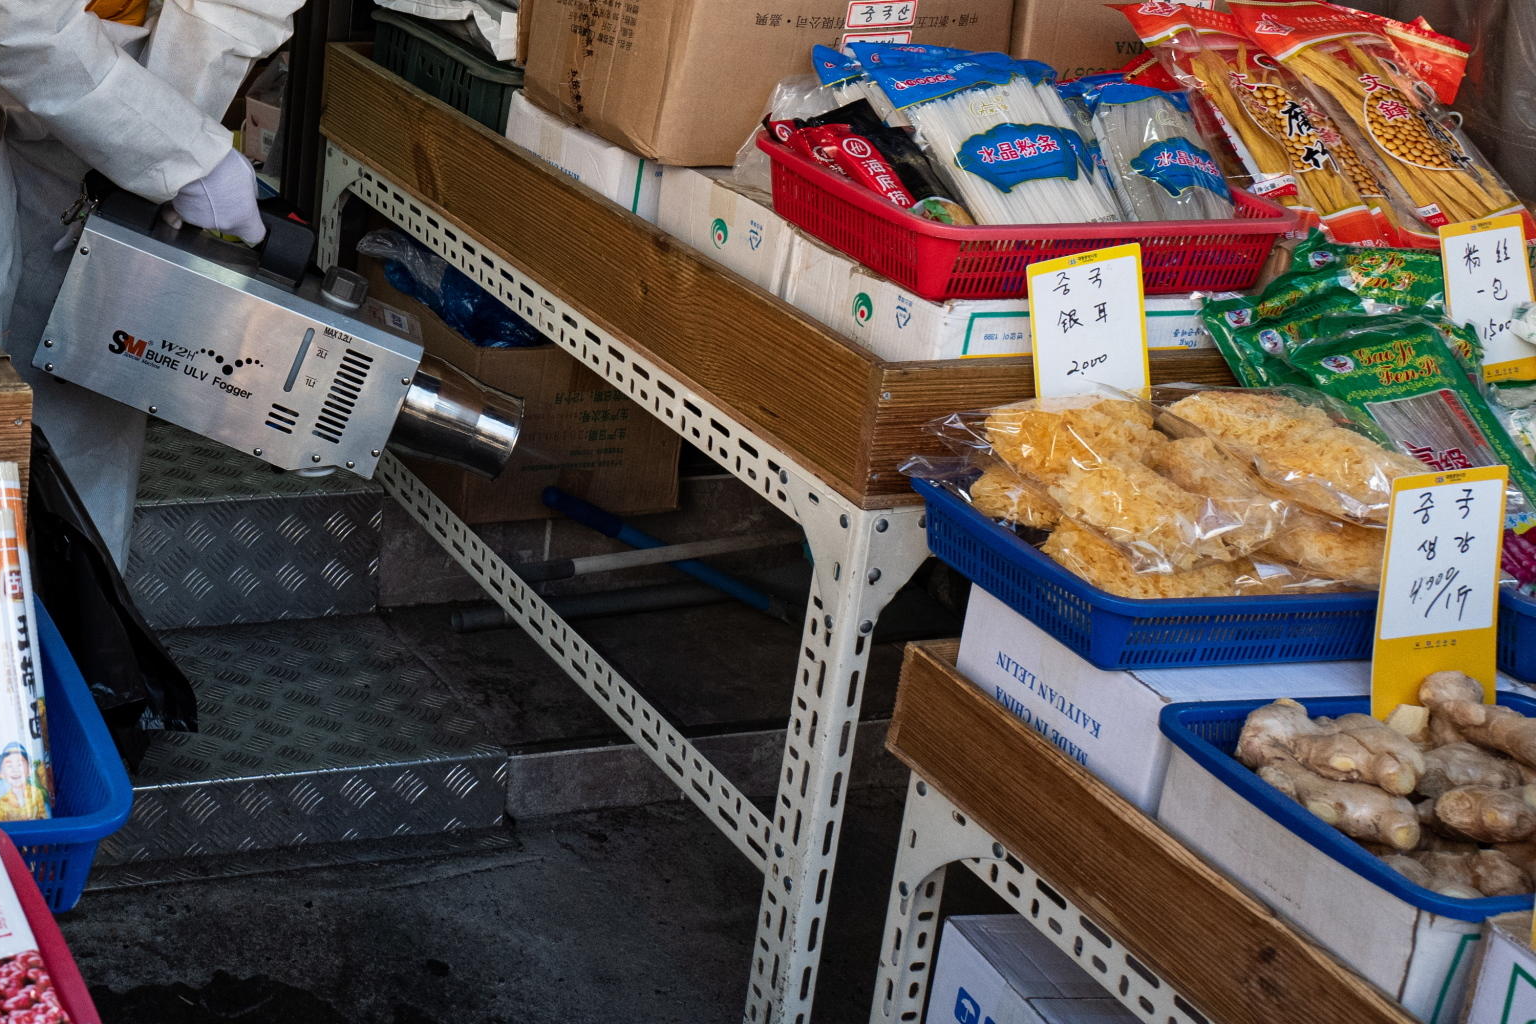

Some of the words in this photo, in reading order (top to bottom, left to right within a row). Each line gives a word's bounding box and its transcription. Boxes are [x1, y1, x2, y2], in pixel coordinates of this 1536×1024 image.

[860, 4, 911, 23] 중국산
[977, 134, 1061, 164] 水晶粉条
[860, 157, 911, 210] 海底捞
[1463, 237, 1511, 275] 粉丝
[1052, 267, 1103, 296] 중국
[108, 329, 148, 359] SM
[323, 326, 338, 339] MAX
[315, 348, 328, 360] 2Lt
[144, 349, 181, 371] BURE
[183, 365, 210, 382] ULV
[211, 376, 253, 400] Fogger
[304, 377, 317, 389] 1Lt
[1379, 365, 1418, 387] Fen
[1418, 357, 1442, 377] Pi
[1413, 488, 1475, 525] 중국
[1417, 531, 1476, 561] 생강
[995, 650, 1037, 692] LELIN
[995, 684, 1033, 724] CHINA
[1037, 680, 1102, 740] KAIYUAN
[1033, 715, 1049, 737] IN
[1051, 728, 1089, 767] MADE
